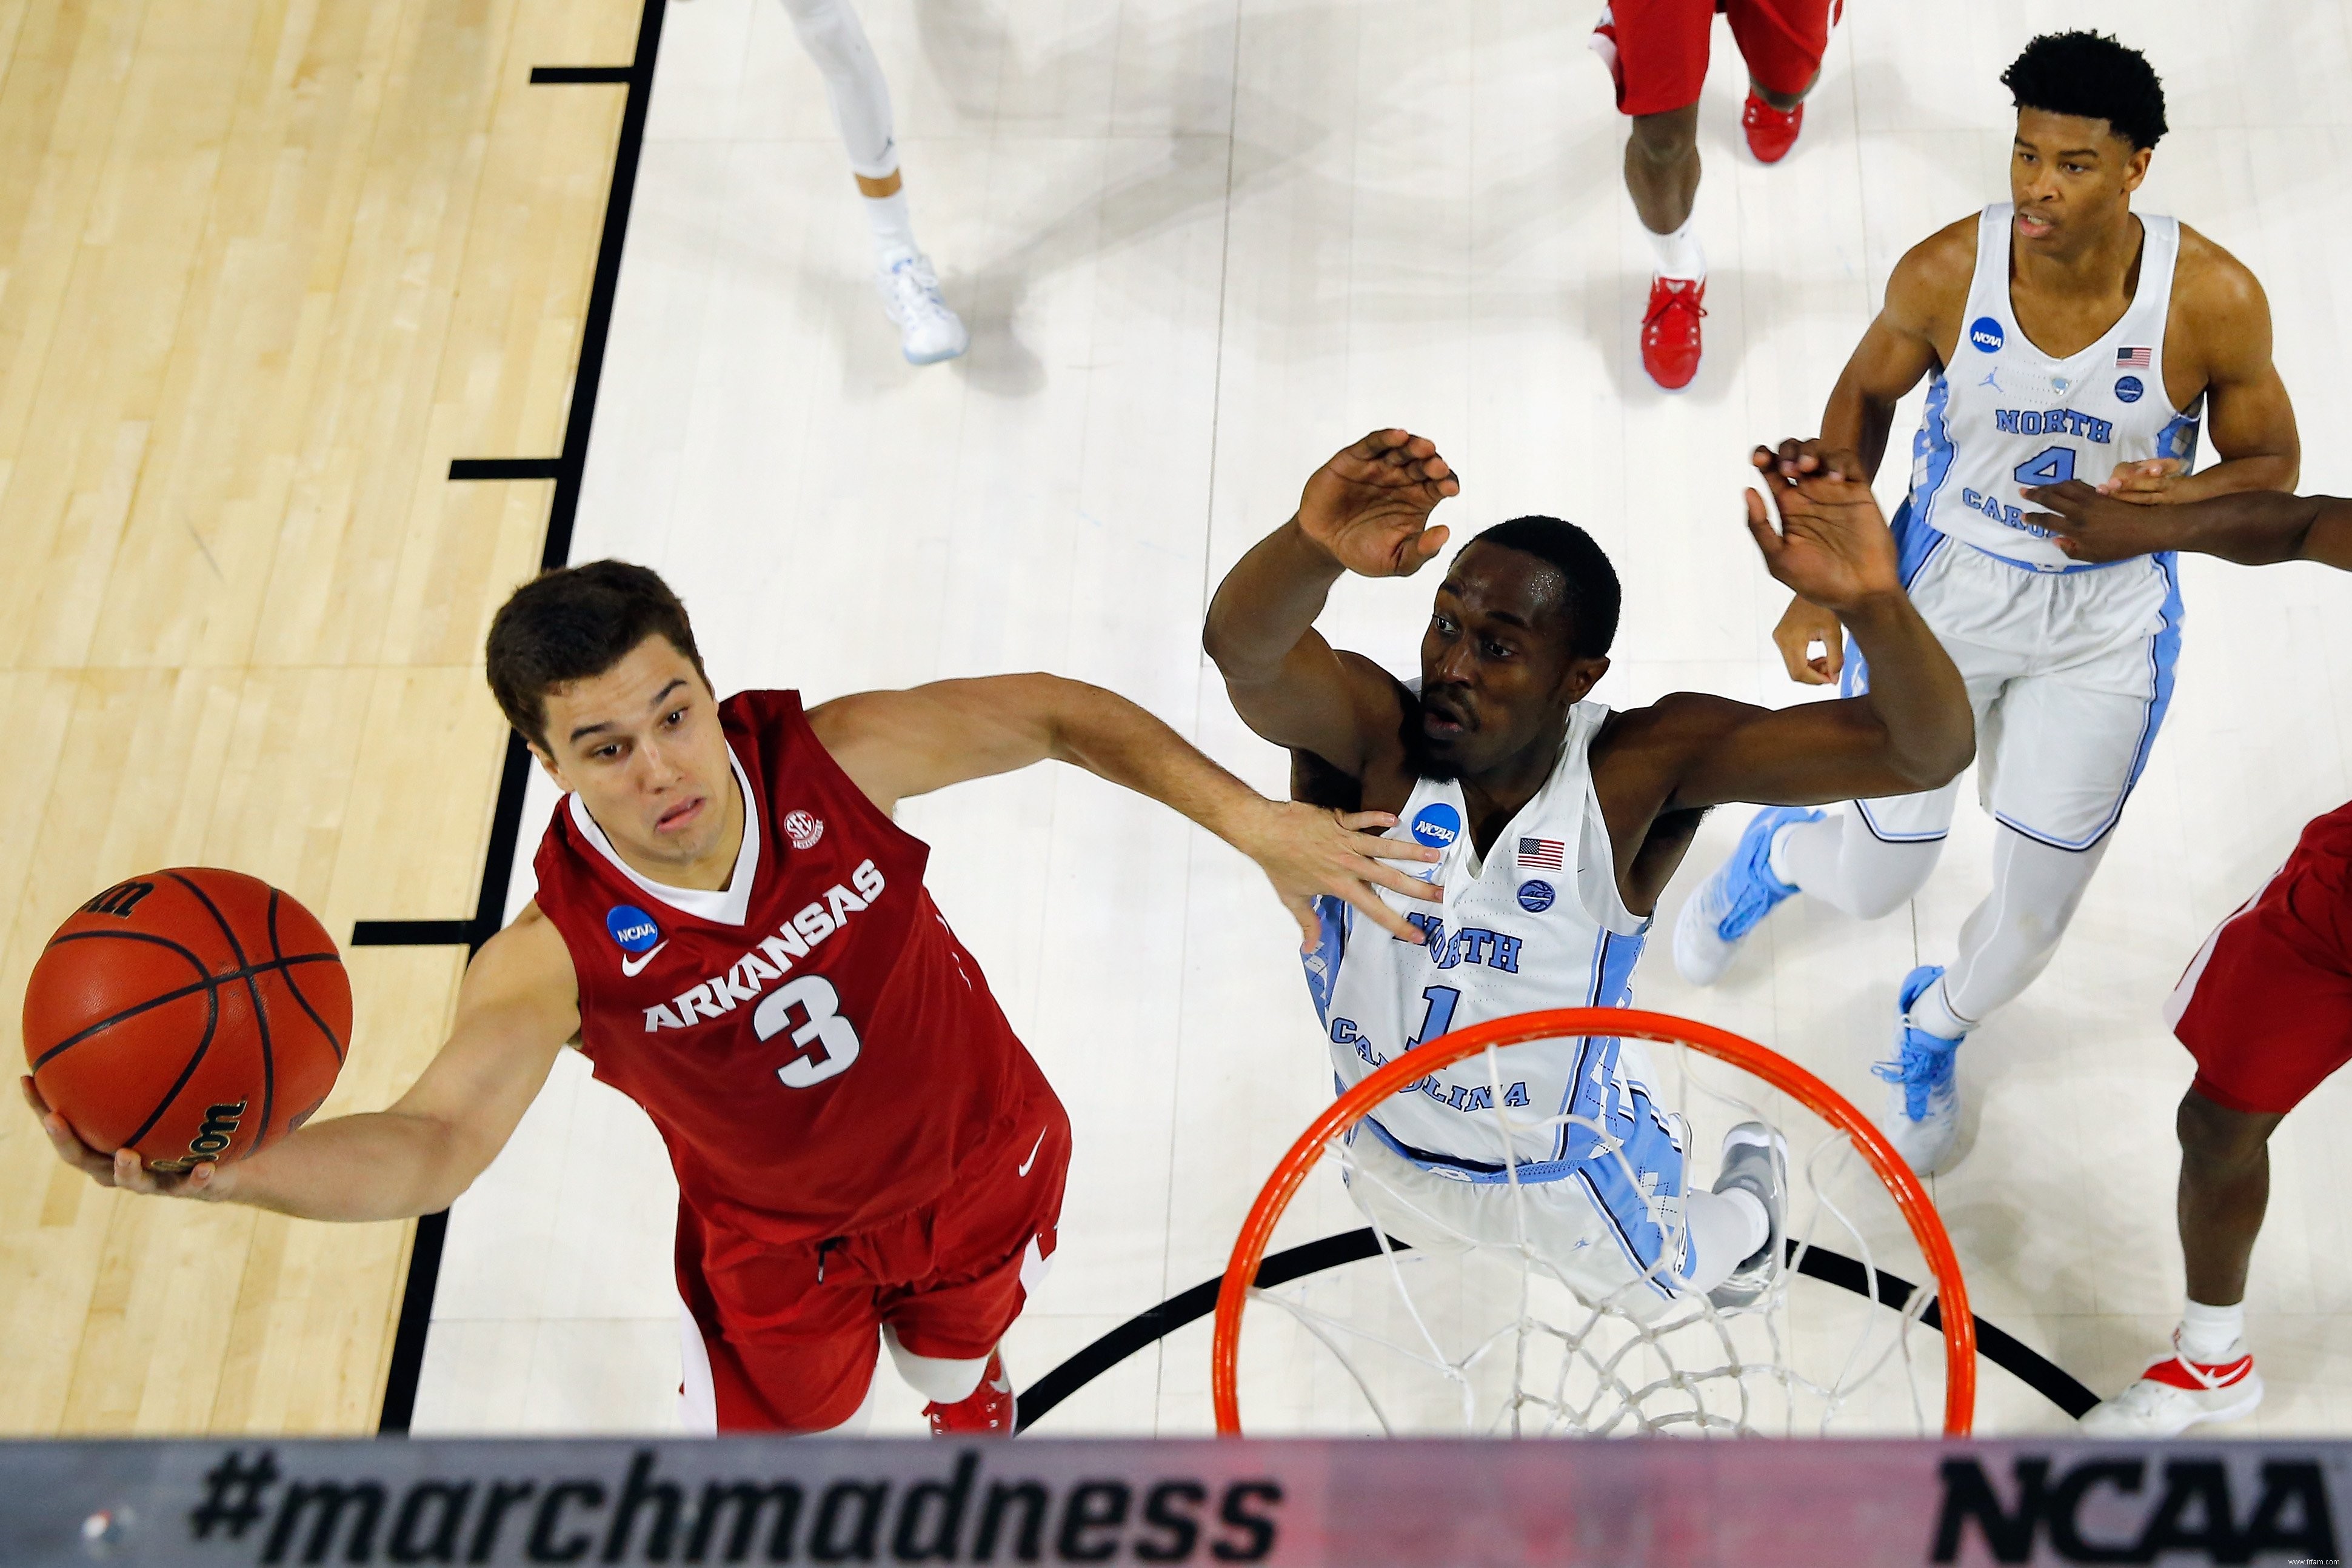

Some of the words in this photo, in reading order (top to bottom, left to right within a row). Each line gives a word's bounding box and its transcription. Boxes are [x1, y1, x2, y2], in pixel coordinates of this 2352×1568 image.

[1973, 331, 2002, 348] NCAA
[1996, 409, 2113, 443] NORTH
[2014, 446, 2076, 487] 4
[787, 813, 812, 838] SEC
[1415, 820, 1455, 843] NCAA
[616, 923, 655, 942] NCAA
[643, 858, 886, 1033] ARKANSAS
[753, 974, 860, 1089] 3
[1405, 984, 1462, 1070] 1
[189, 1448, 1284, 1564] #marchmadness
[1932, 1455, 2339, 1564] NCAA
